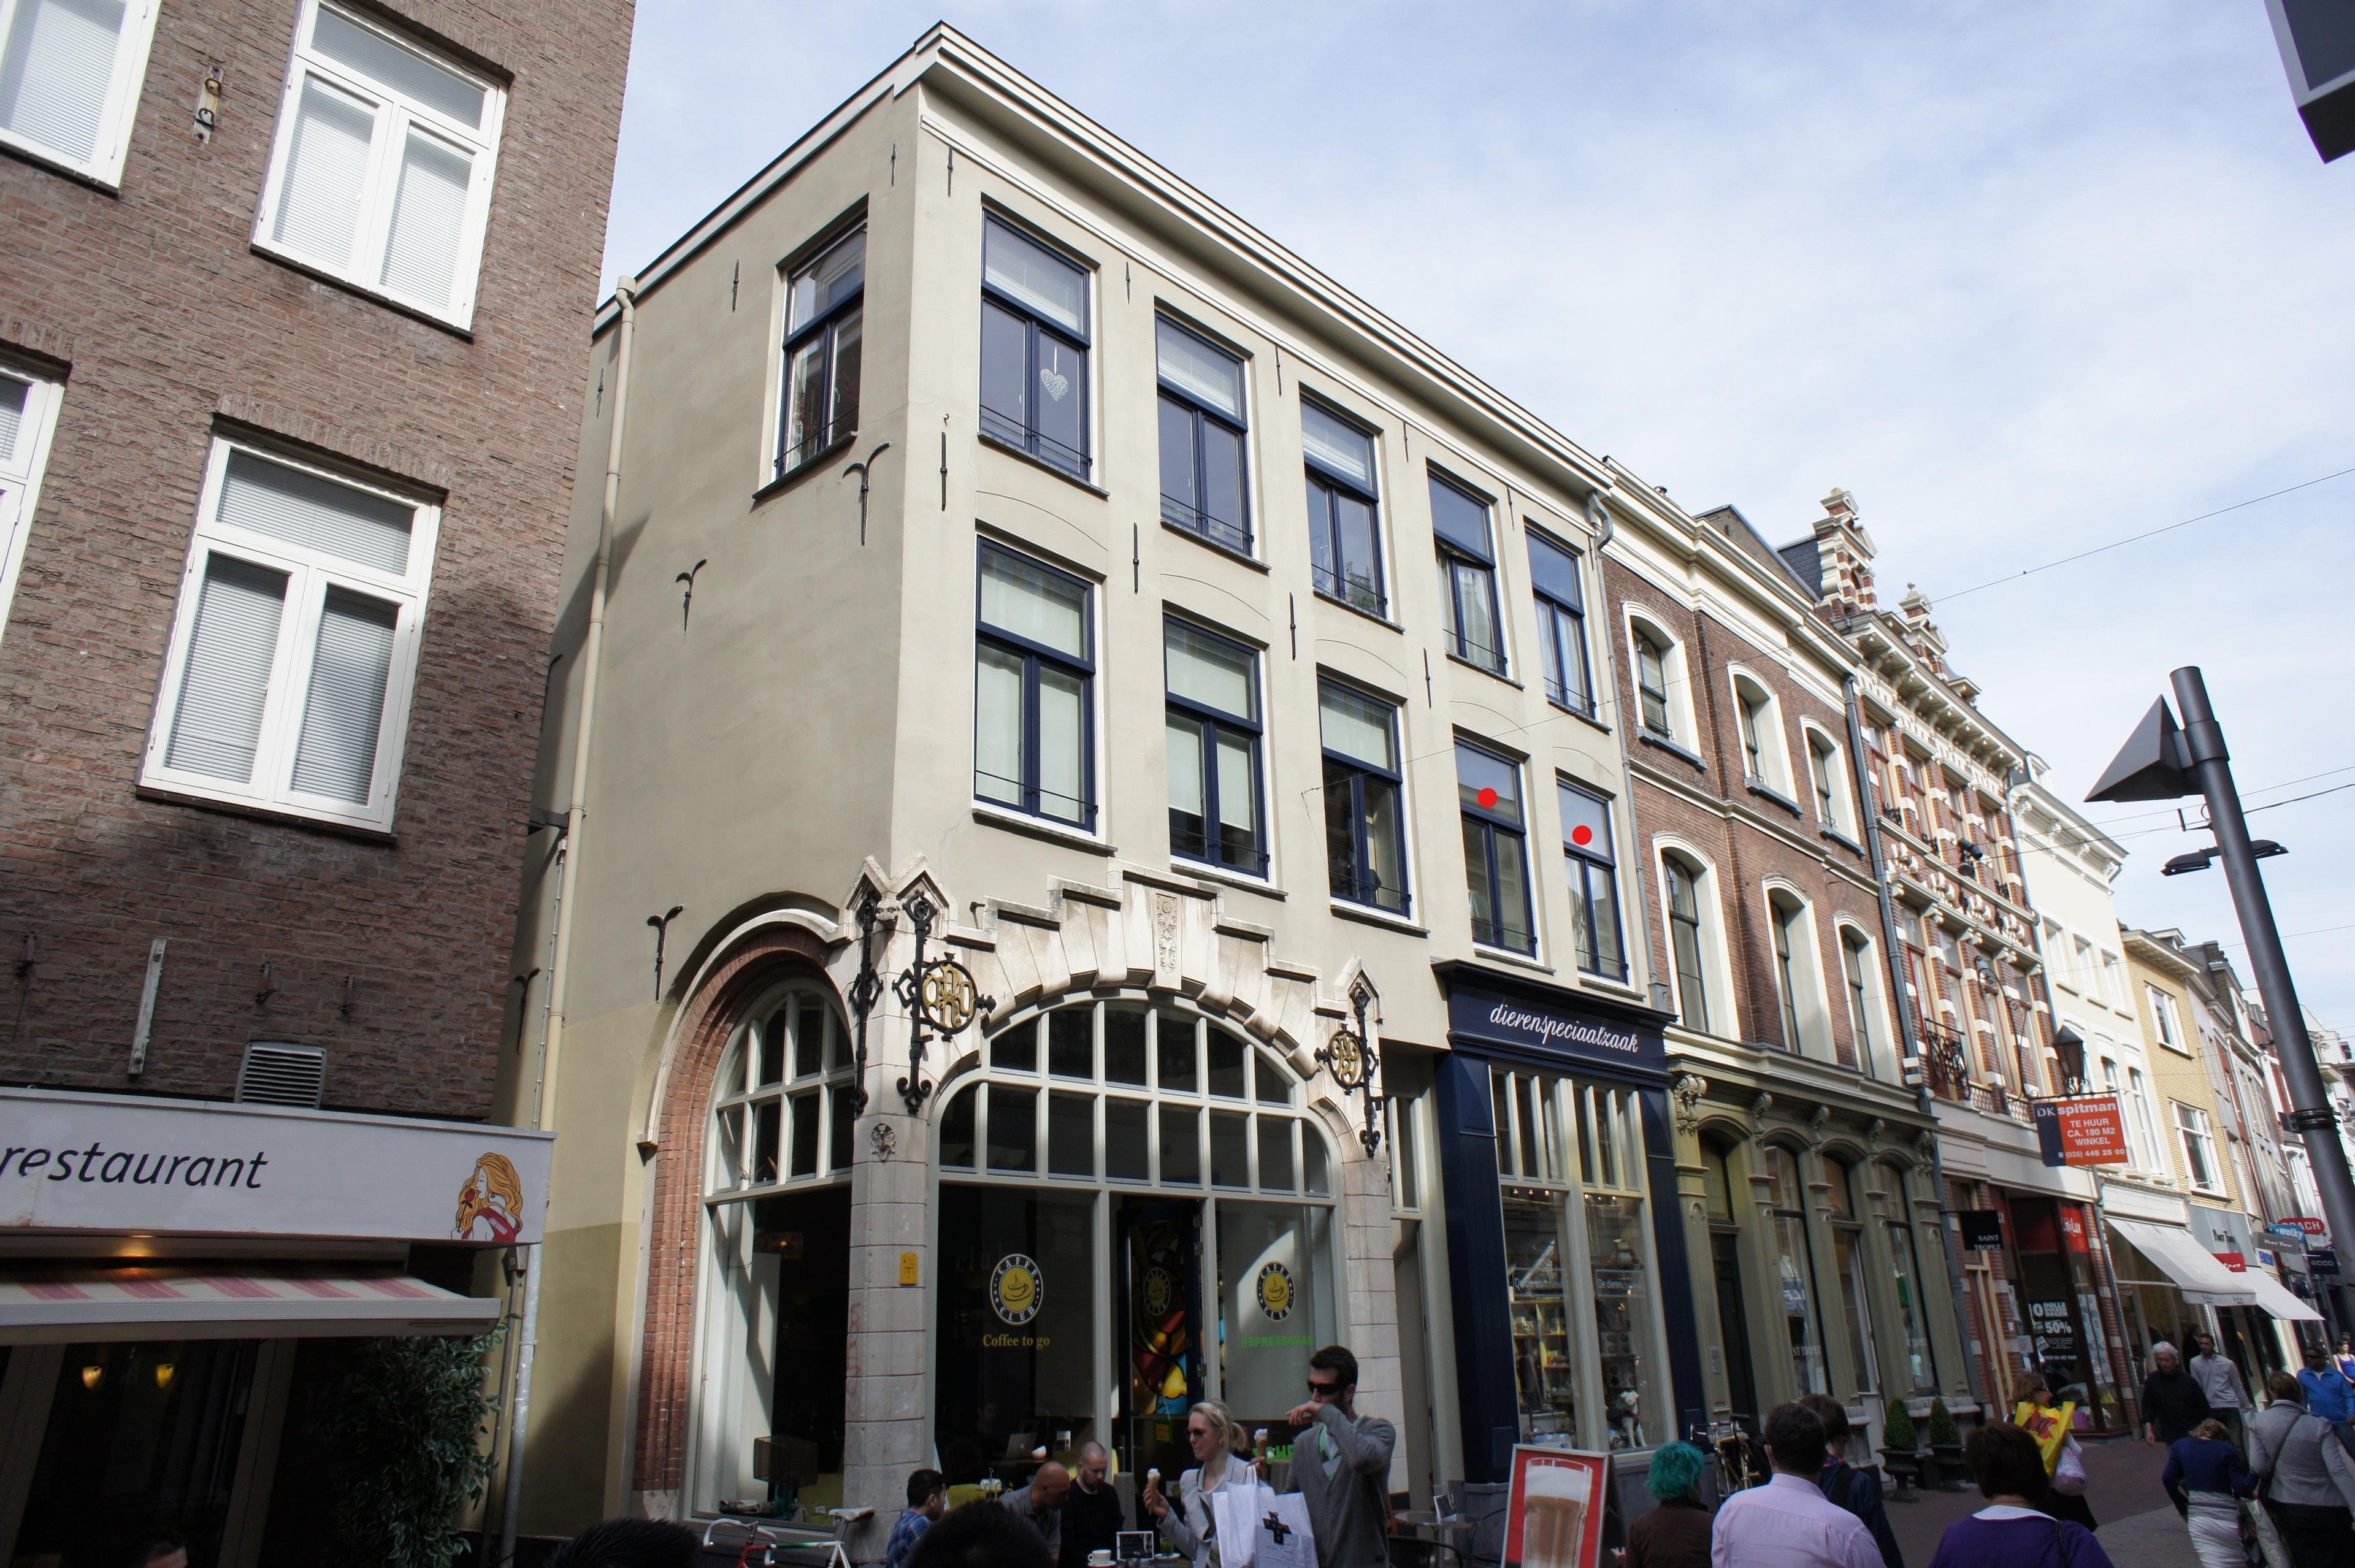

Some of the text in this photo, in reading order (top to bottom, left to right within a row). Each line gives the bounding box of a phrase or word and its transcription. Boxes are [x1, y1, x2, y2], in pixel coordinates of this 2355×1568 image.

[1489, 1004, 1639, 1053] dierenspeciaalzaak
[2057, 1103, 2116, 1117] spitman
[2083, 1118, 2110, 1126] HUUR
[2075, 1137, 2111, 1146] WINKEL
[0, 1142, 269, 1189] restaurant
[2280, 1221, 2321, 1230] ACH
[2278, 1227, 2303, 1240] wolky
[997, 1256, 1038, 1277] CAFFE
[1000, 1305, 1036, 1321] CLUB
[2044, 1321, 2072, 1334] 50%
[982, 1334, 1050, 1350] Coffee to go
